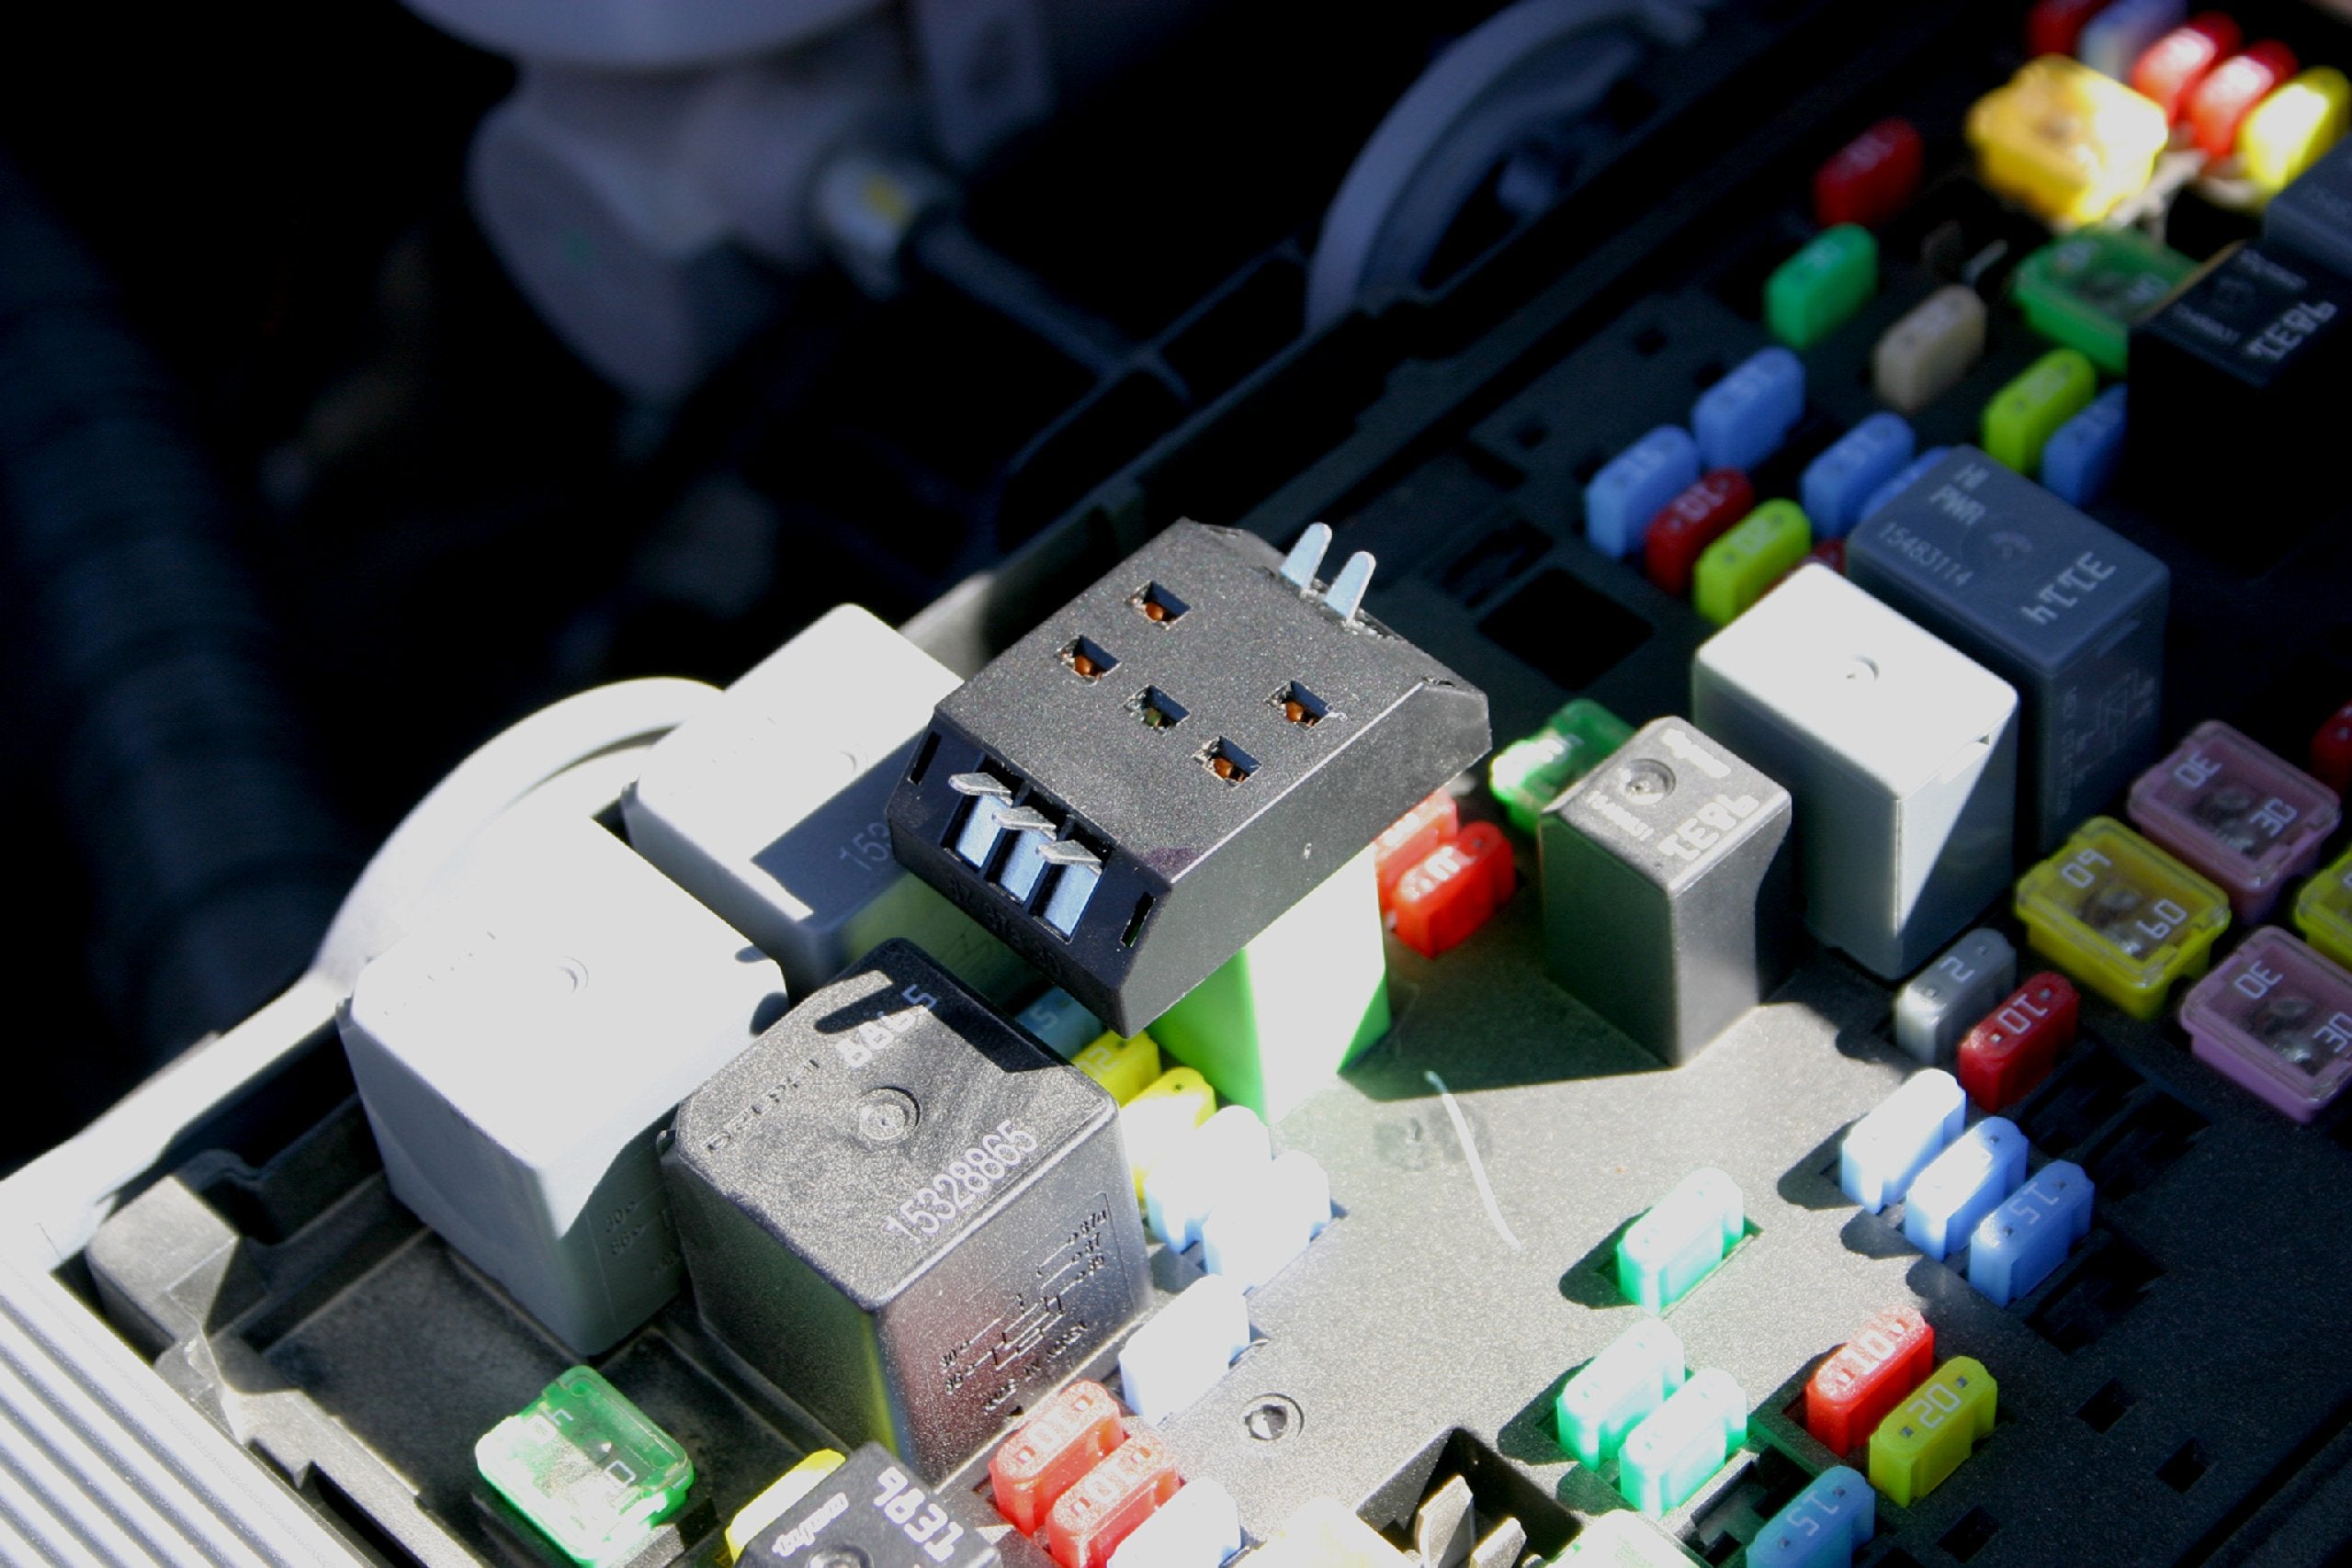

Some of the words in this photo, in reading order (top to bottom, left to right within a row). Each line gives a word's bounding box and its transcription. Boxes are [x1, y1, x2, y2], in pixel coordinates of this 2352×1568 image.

[1930, 484, 1986, 526] PWR
[1879, 522, 1975, 587] 15483114
[2021, 551, 2117, 626] 3114
[2173, 750, 2222, 790] 30
[1657, 794, 1760, 862] 9831
[2249, 796, 2299, 838] 30
[2060, 848, 2112, 888] 60
[2136, 897, 2188, 941] 60
[1939, 954, 1975, 985] 2
[2233, 960, 2284, 1000] 30
[1996, 992, 2050, 1036] 10
[2312, 1010, 2352, 1055] 30
[885, 1117, 1040, 1247] 15328865
[2007, 1181, 2059, 1225] 15
[1850, 1328, 1898, 1376] 10
[1906, 1382, 1962, 1430] 20
[873, 1466, 965, 1562] 9831
[1785, 1489, 1839, 1537] 15
